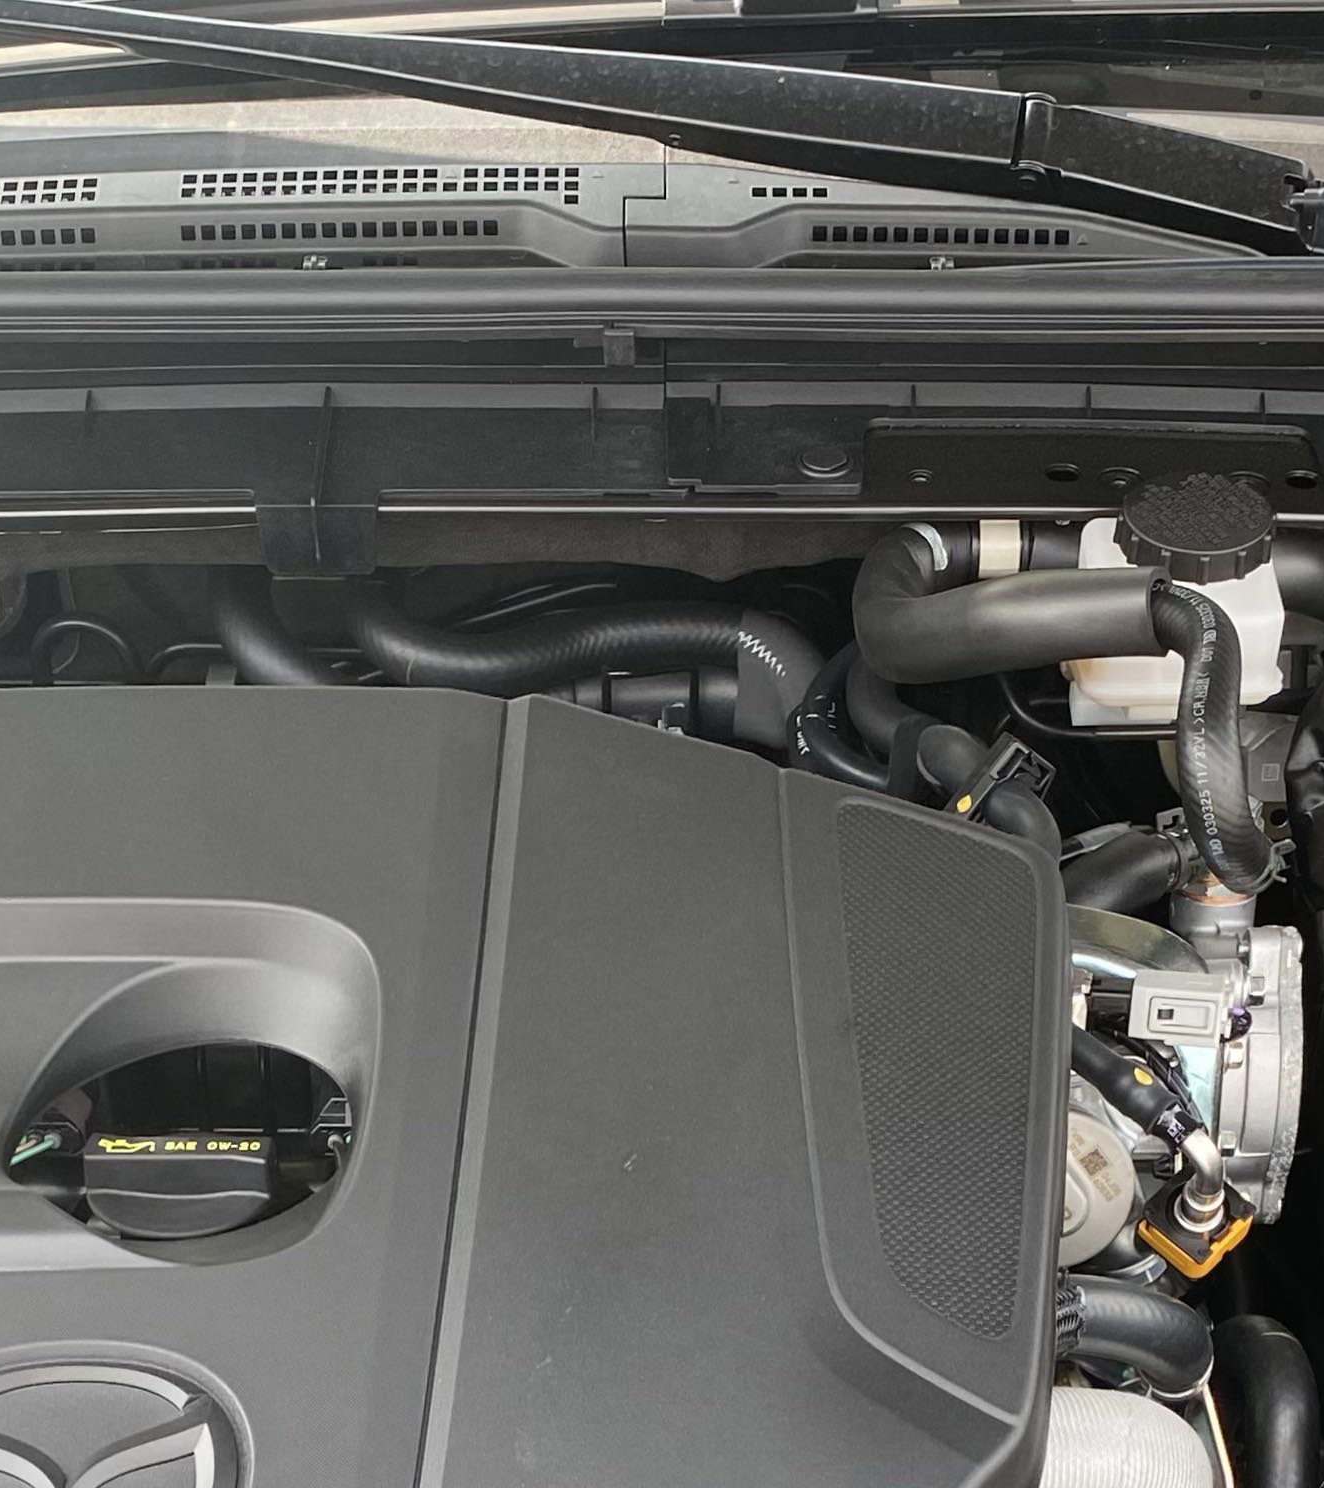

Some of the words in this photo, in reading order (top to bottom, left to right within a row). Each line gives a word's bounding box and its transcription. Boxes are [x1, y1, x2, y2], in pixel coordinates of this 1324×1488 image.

[1199, 789, 1218, 836] 030325
[164, 1141, 198, 1151] SAE
[206, 1141, 261, 1151] 0W-20
